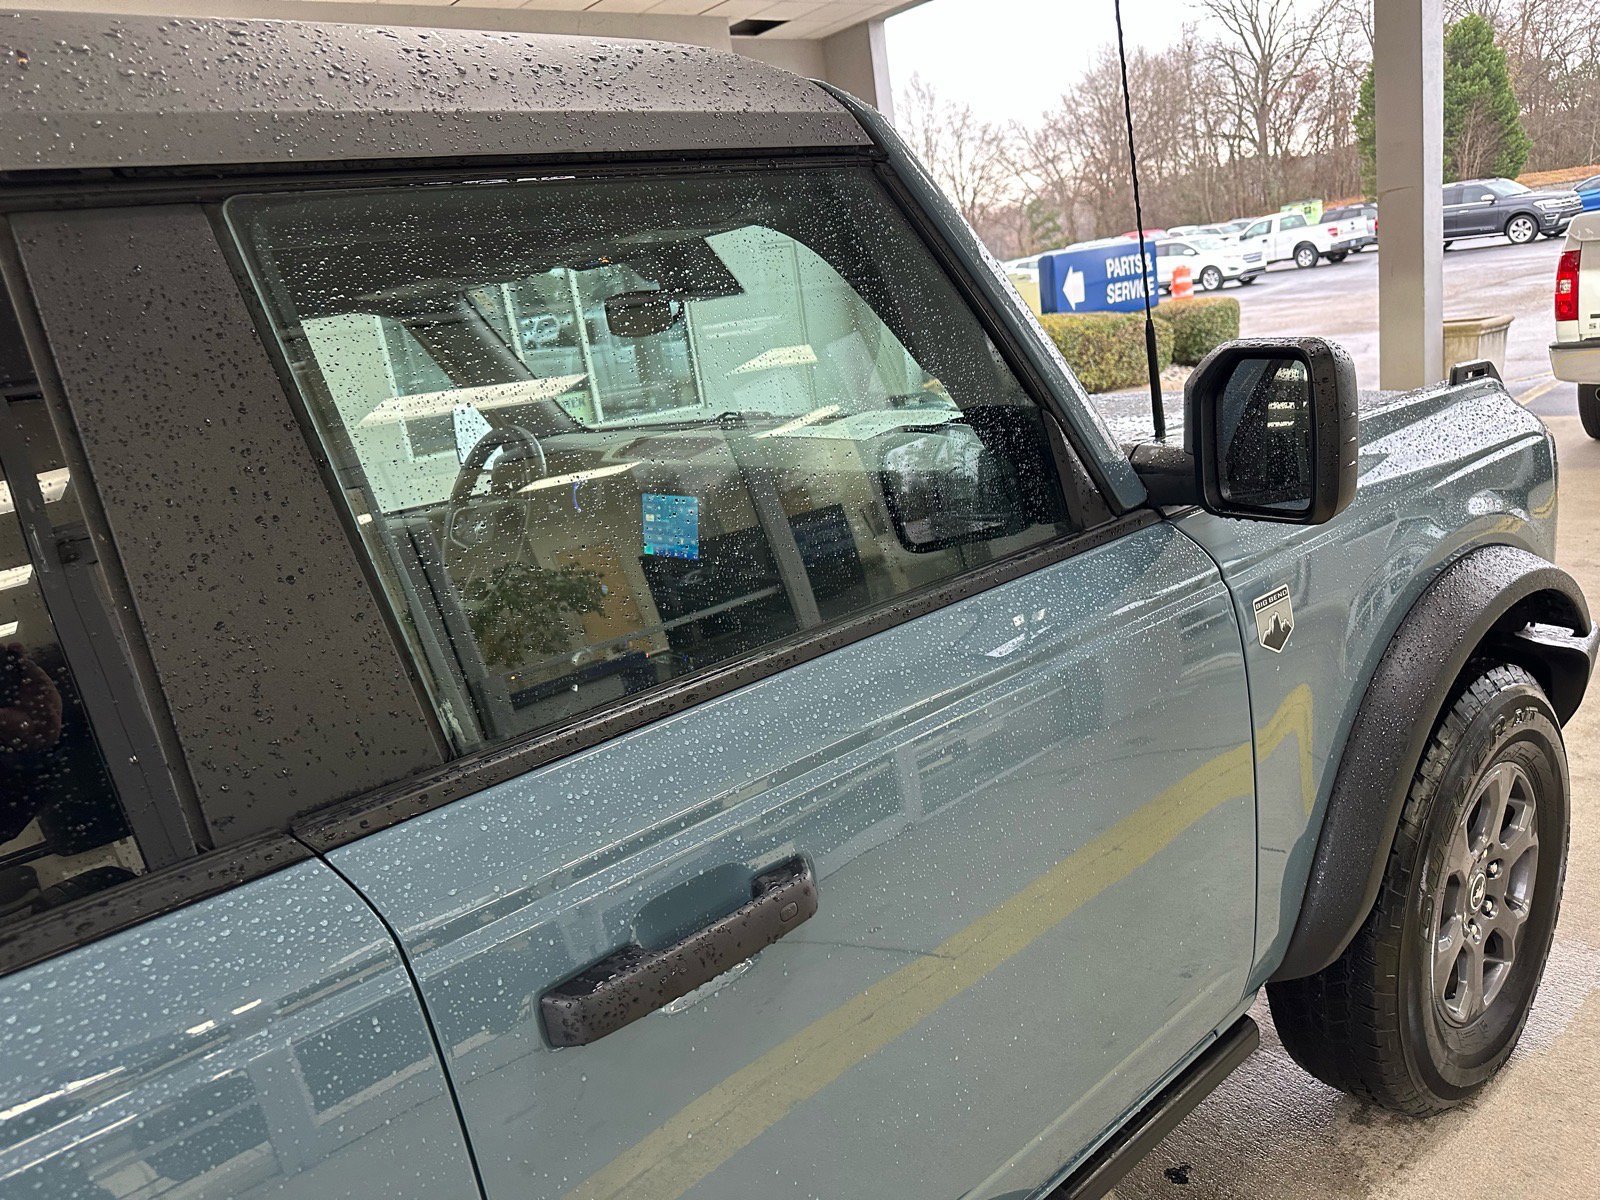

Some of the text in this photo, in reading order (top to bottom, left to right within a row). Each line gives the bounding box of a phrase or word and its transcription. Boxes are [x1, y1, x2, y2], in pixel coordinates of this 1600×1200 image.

[1105, 253, 1143, 279] PARTS
[1255, 589, 1288, 610] BIG BEND
